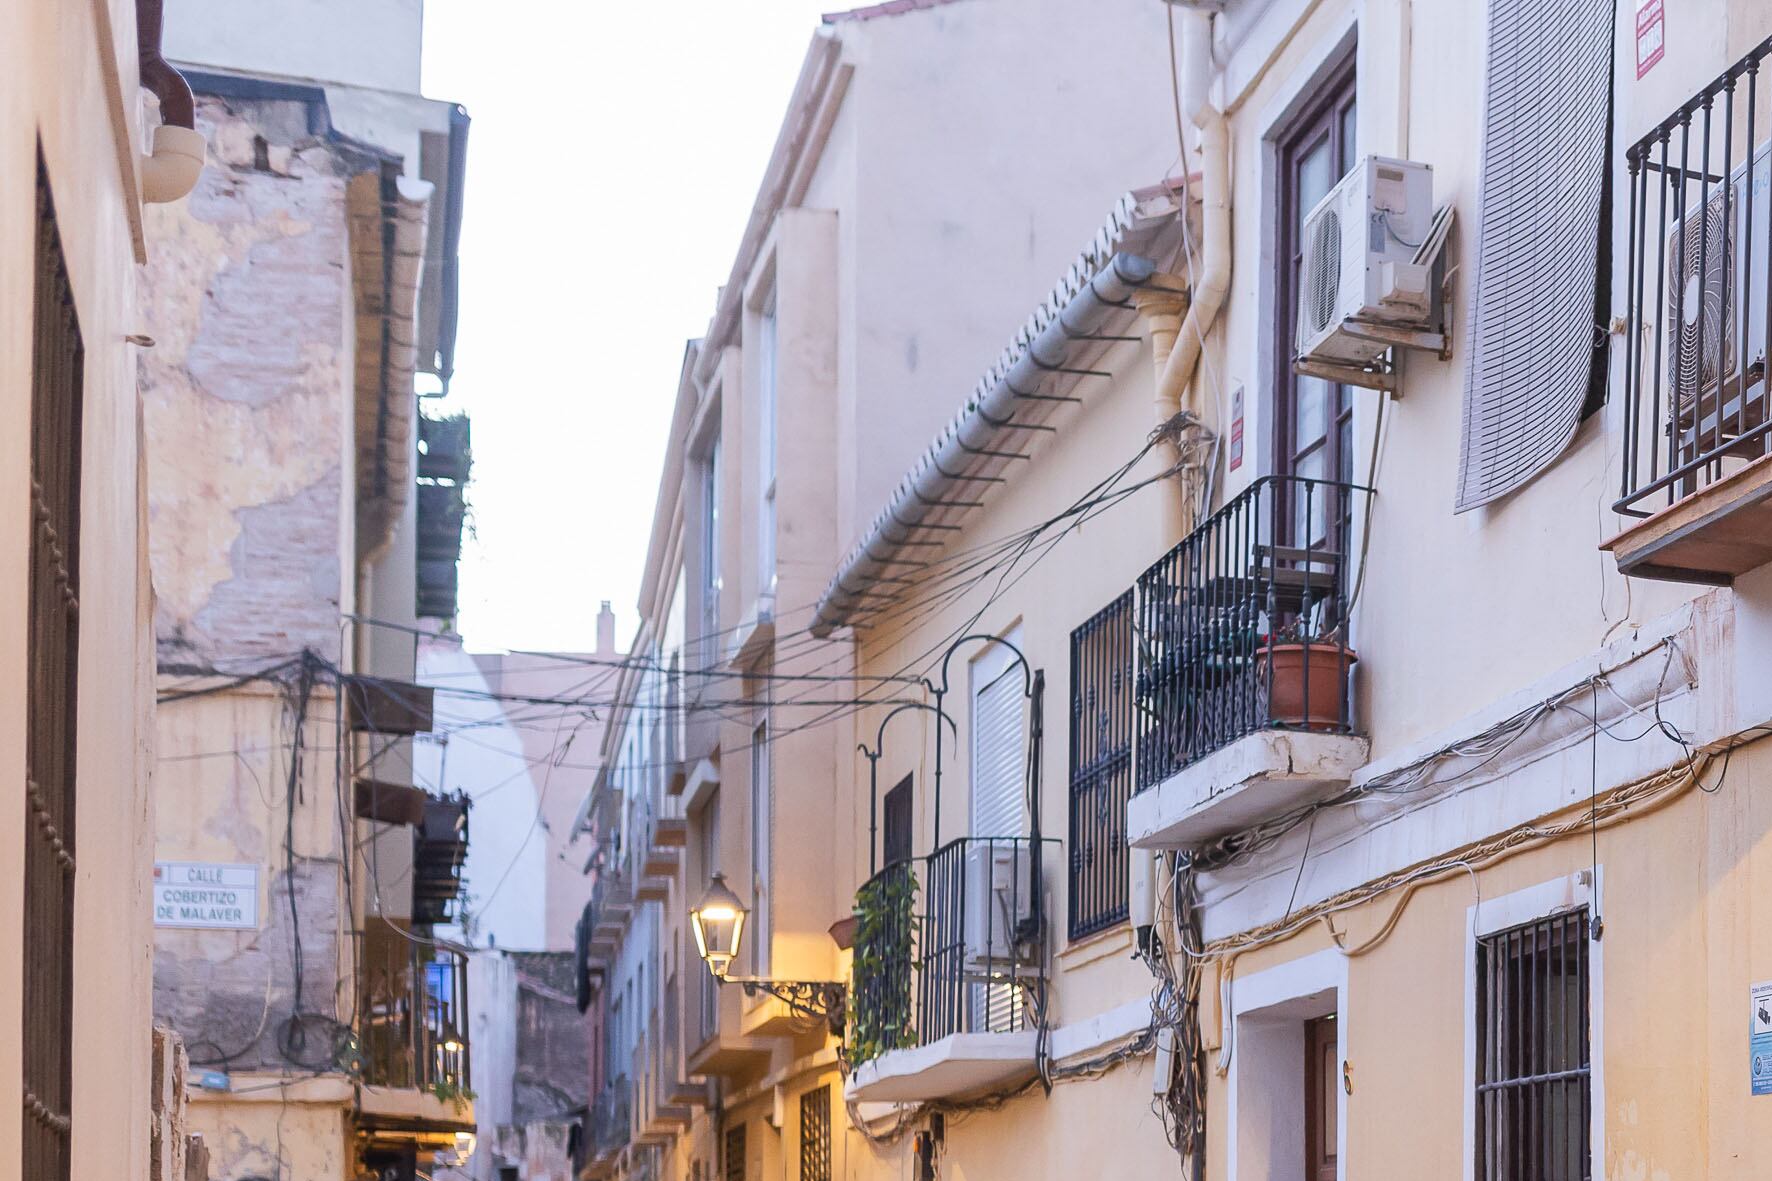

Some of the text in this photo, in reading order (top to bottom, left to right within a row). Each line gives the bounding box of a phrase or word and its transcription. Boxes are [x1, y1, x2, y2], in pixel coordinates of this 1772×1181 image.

[187, 867, 224, 883] CALLE
[163, 889, 236, 905] COBERTIZO
[157, 905, 242, 921] DE MALAVER
